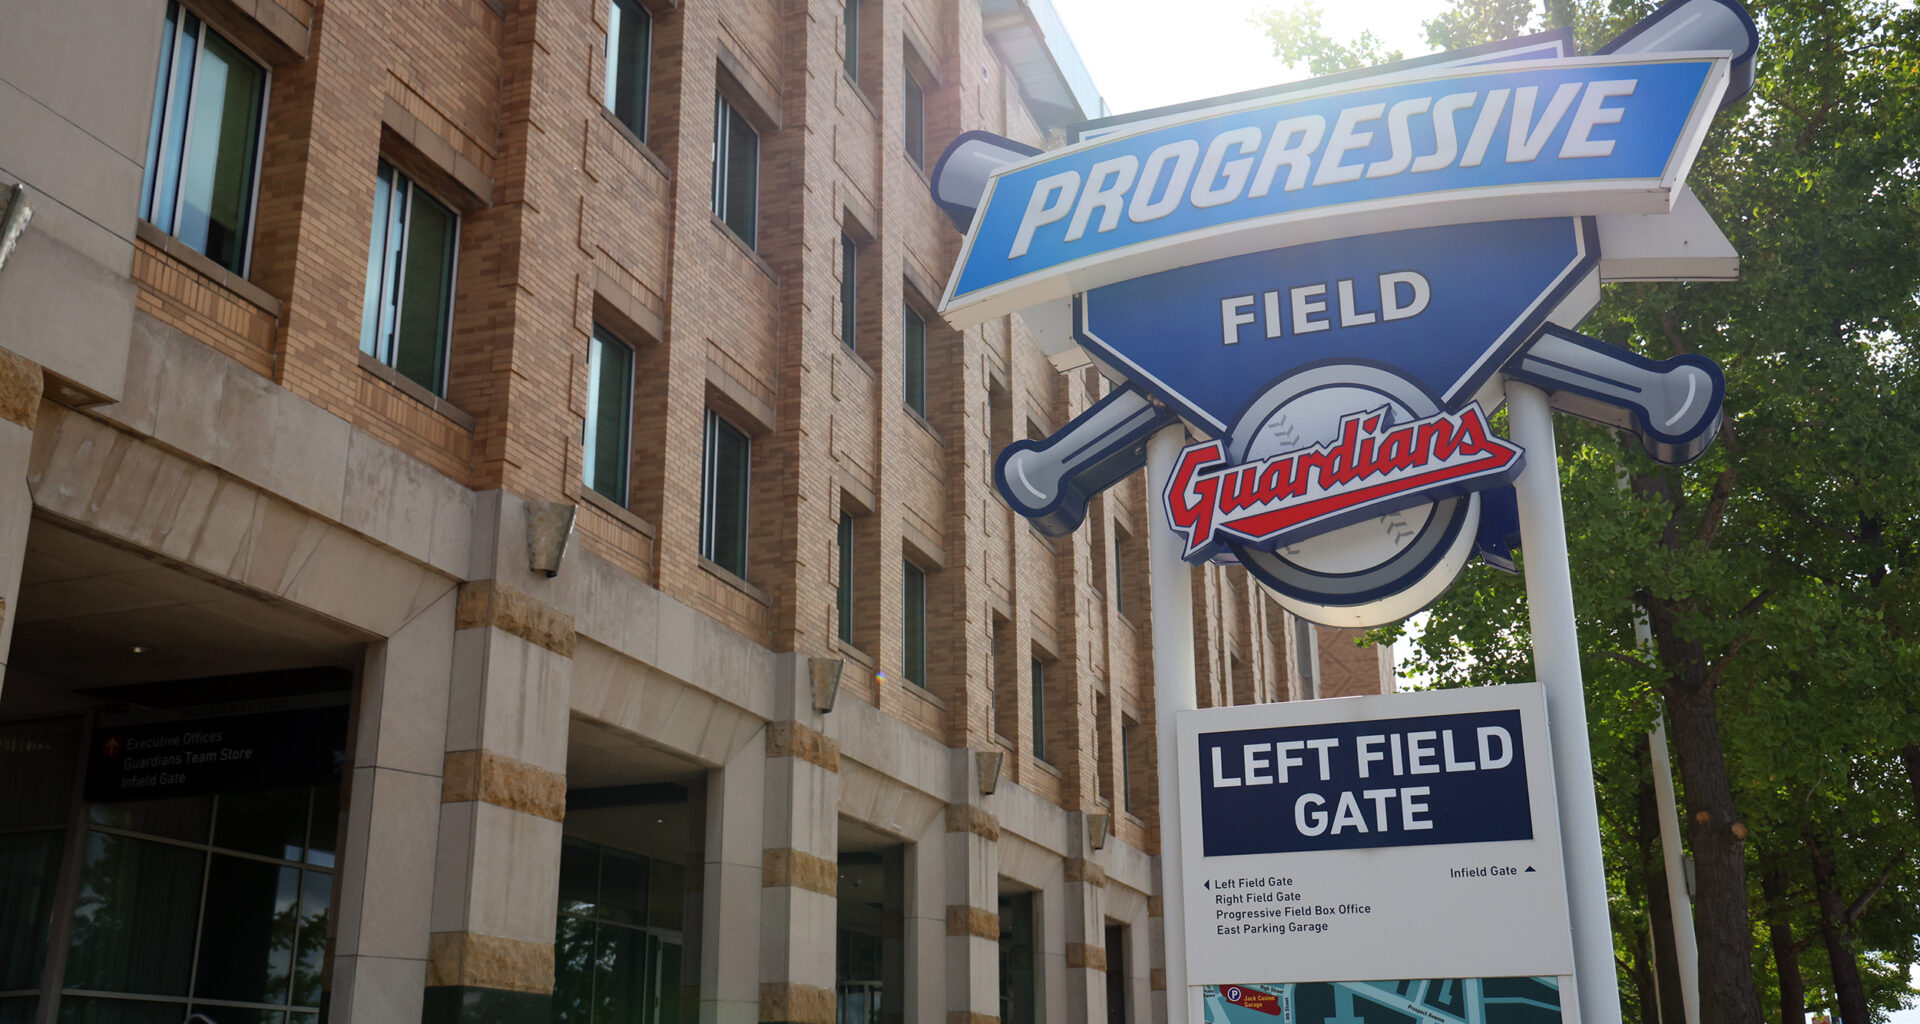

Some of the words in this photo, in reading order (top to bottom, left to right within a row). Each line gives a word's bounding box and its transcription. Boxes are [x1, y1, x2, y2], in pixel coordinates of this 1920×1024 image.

[1007, 78, 1640, 260] PROGRESSIVE
[1221, 270, 1432, 346] FIELD
[1164, 402, 1522, 558] Guardians
[126, 735, 181, 751] Executive
[183, 731, 223, 745] Offices
[123, 753, 182, 770] Guardians
[185, 751, 217, 764] Team
[220, 747, 253, 761] Store
[1211, 737, 1340, 788] LEFT
[1356, 725, 1514, 779] FIELD
[120, 773, 157, 789] Infield
[159, 771, 187, 785] Gate
[1294, 785, 1434, 837] GATE
[1450, 866, 1487, 878] Infield
[1490, 865, 1517, 876] Gate
[1215, 879, 1236, 889] Left
[1238, 877, 1265, 888] Field
[1268, 876, 1293, 887] Gate
[1215, 894, 1244, 906] Right
[1246, 892, 1273, 903] Field
[1276, 891, 1301, 902] Gate
[1216, 907, 1281, 921] Progressive
[1284, 905, 1312, 917] Field
[1315, 905, 1336, 916] Box
[1338, 904, 1371, 915] Office
[1217, 925, 1240, 935] East
[1243, 923, 1286, 935] Parking
[1288, 922, 1328, 934] Garage
[1408, 1004, 1427, 1016] Prospect
[1428, 1013, 1445, 1023] Avenue
